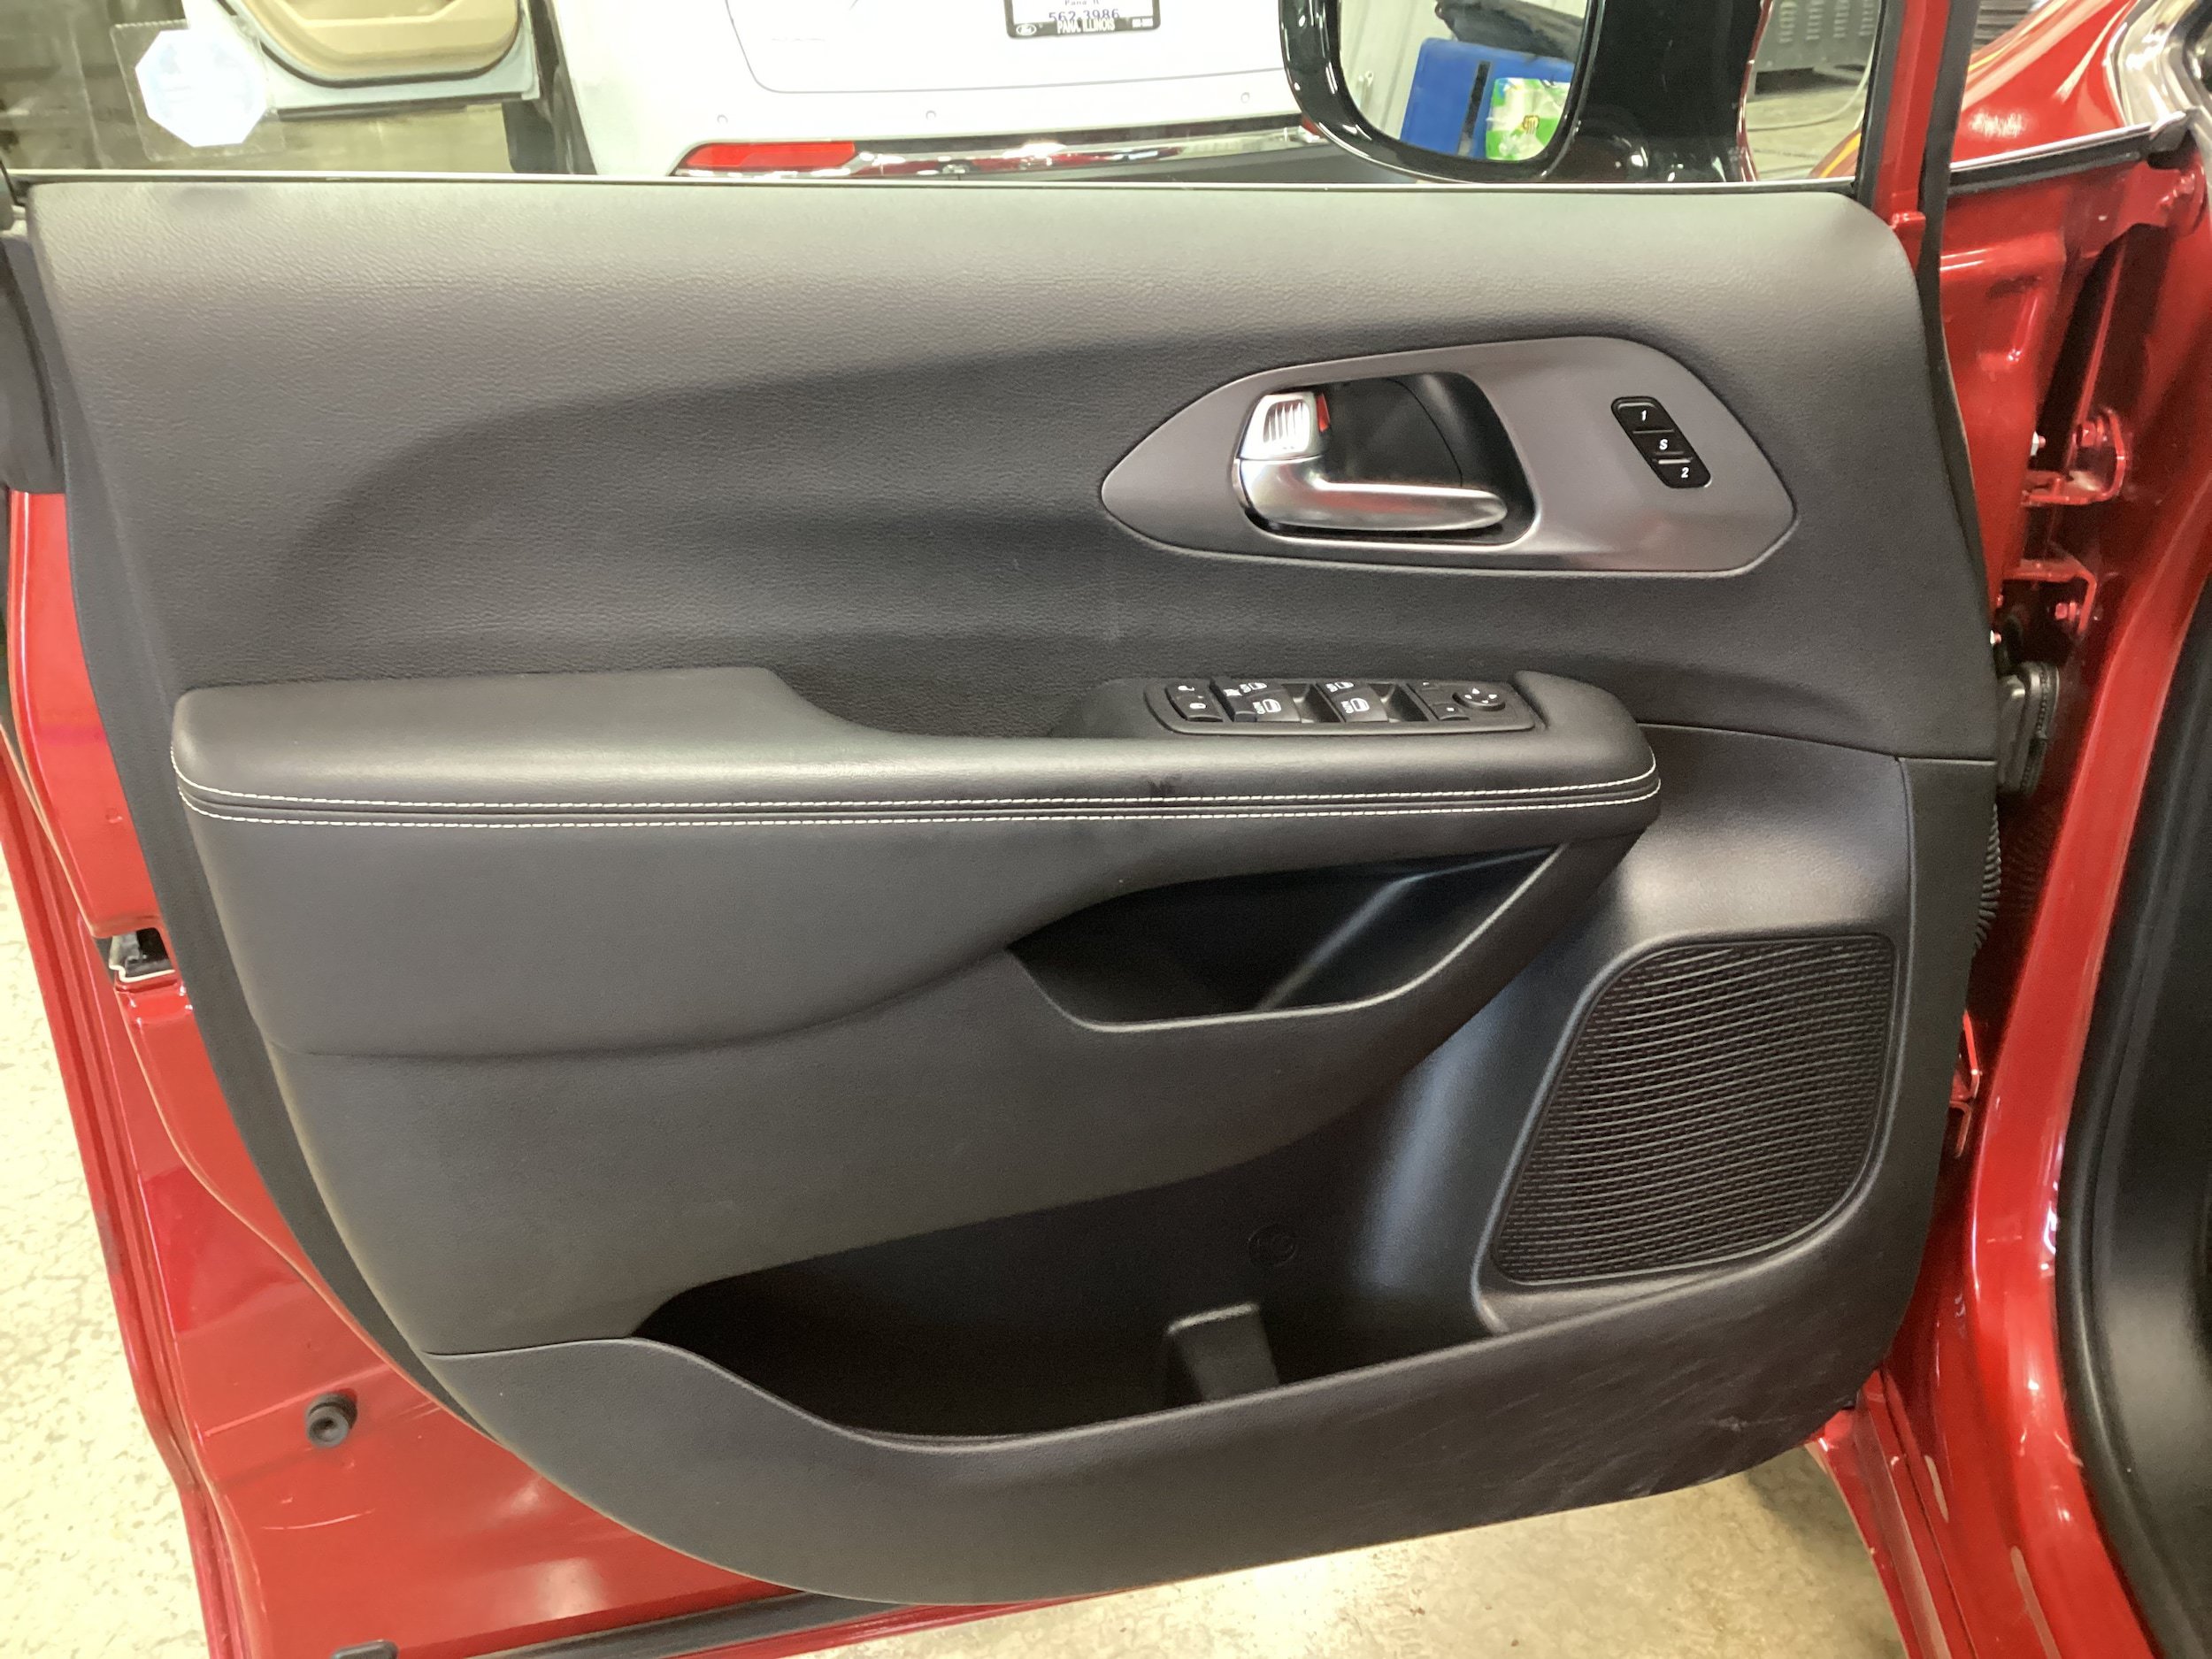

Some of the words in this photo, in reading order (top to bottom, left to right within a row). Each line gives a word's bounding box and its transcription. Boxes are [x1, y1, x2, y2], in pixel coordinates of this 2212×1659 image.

[1082, 18, 1116, 32] ILLINOIS
[1641, 410, 1647, 421] 1
[1659, 438, 1669, 450] S
[1681, 466, 1690, 479] 2
